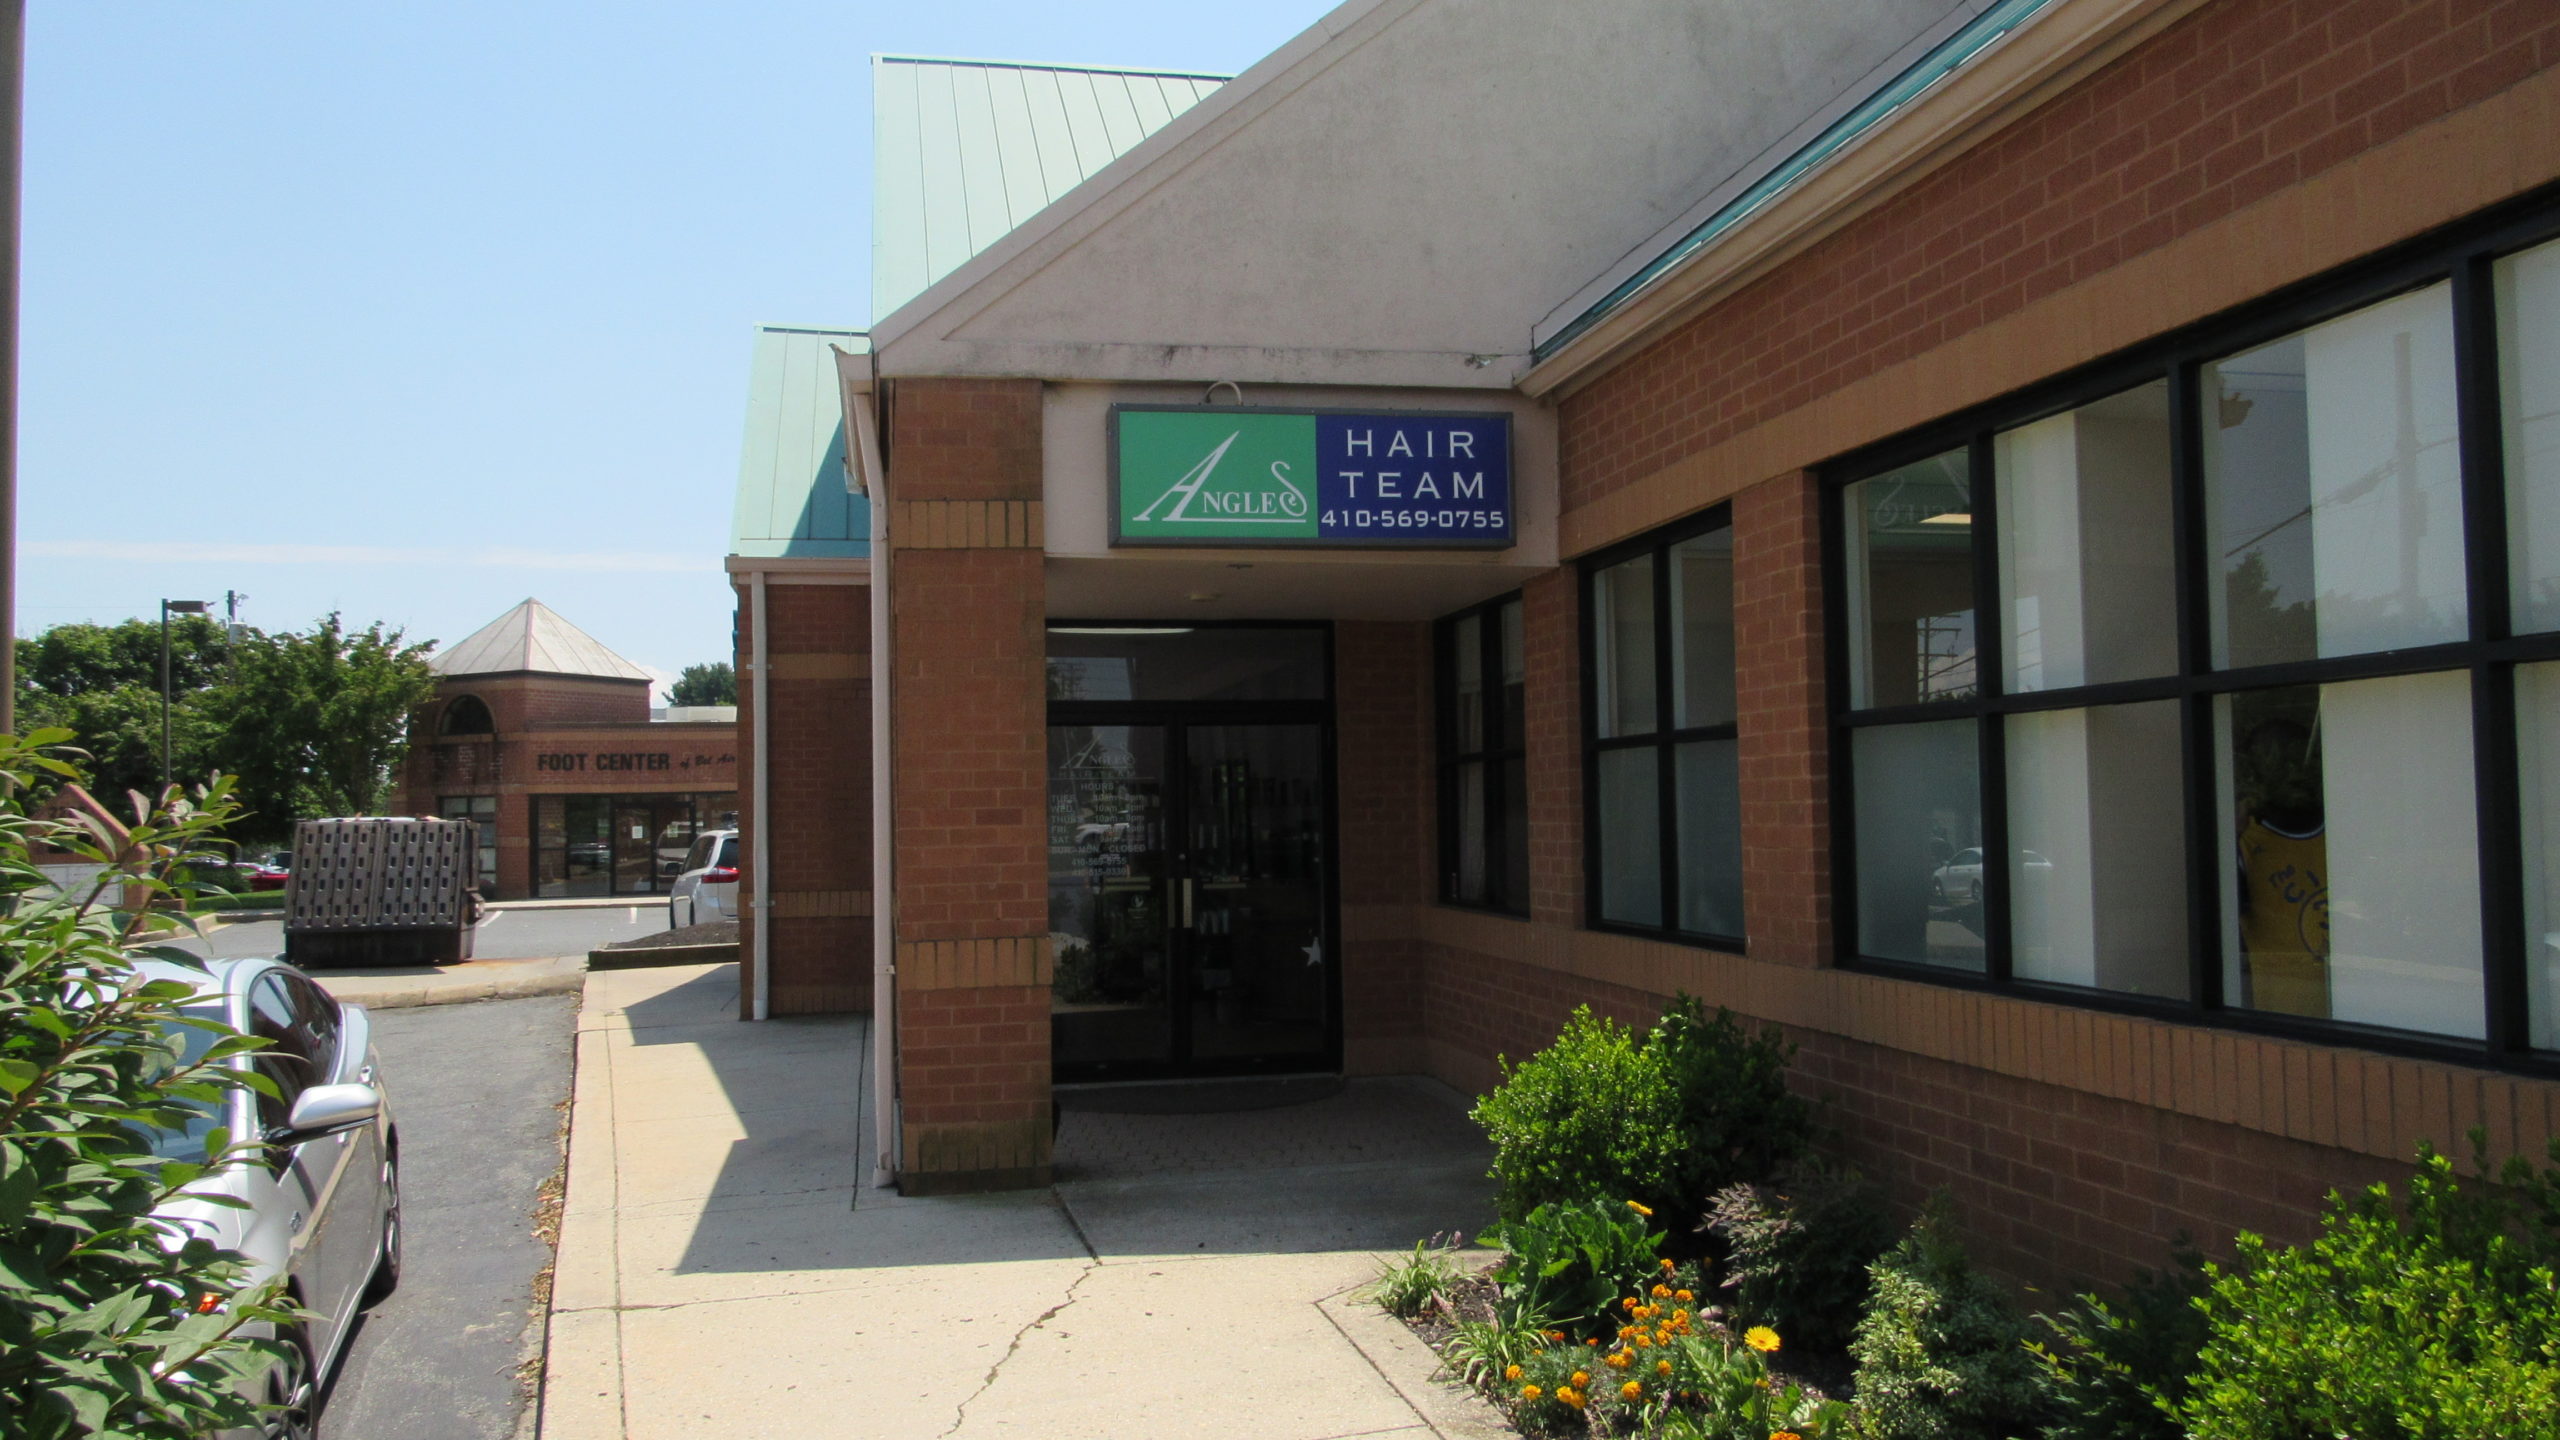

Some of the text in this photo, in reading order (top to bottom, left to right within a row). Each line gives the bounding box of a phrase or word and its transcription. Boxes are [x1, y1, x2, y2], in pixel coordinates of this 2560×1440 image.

[1346, 428, 1475, 459] HAIR
[1339, 471, 1485, 500] TEAM
[1321, 509, 1504, 528] 410-569-0755
[537, 753, 588, 771] FOOT
[596, 753, 671, 771] CENTER
